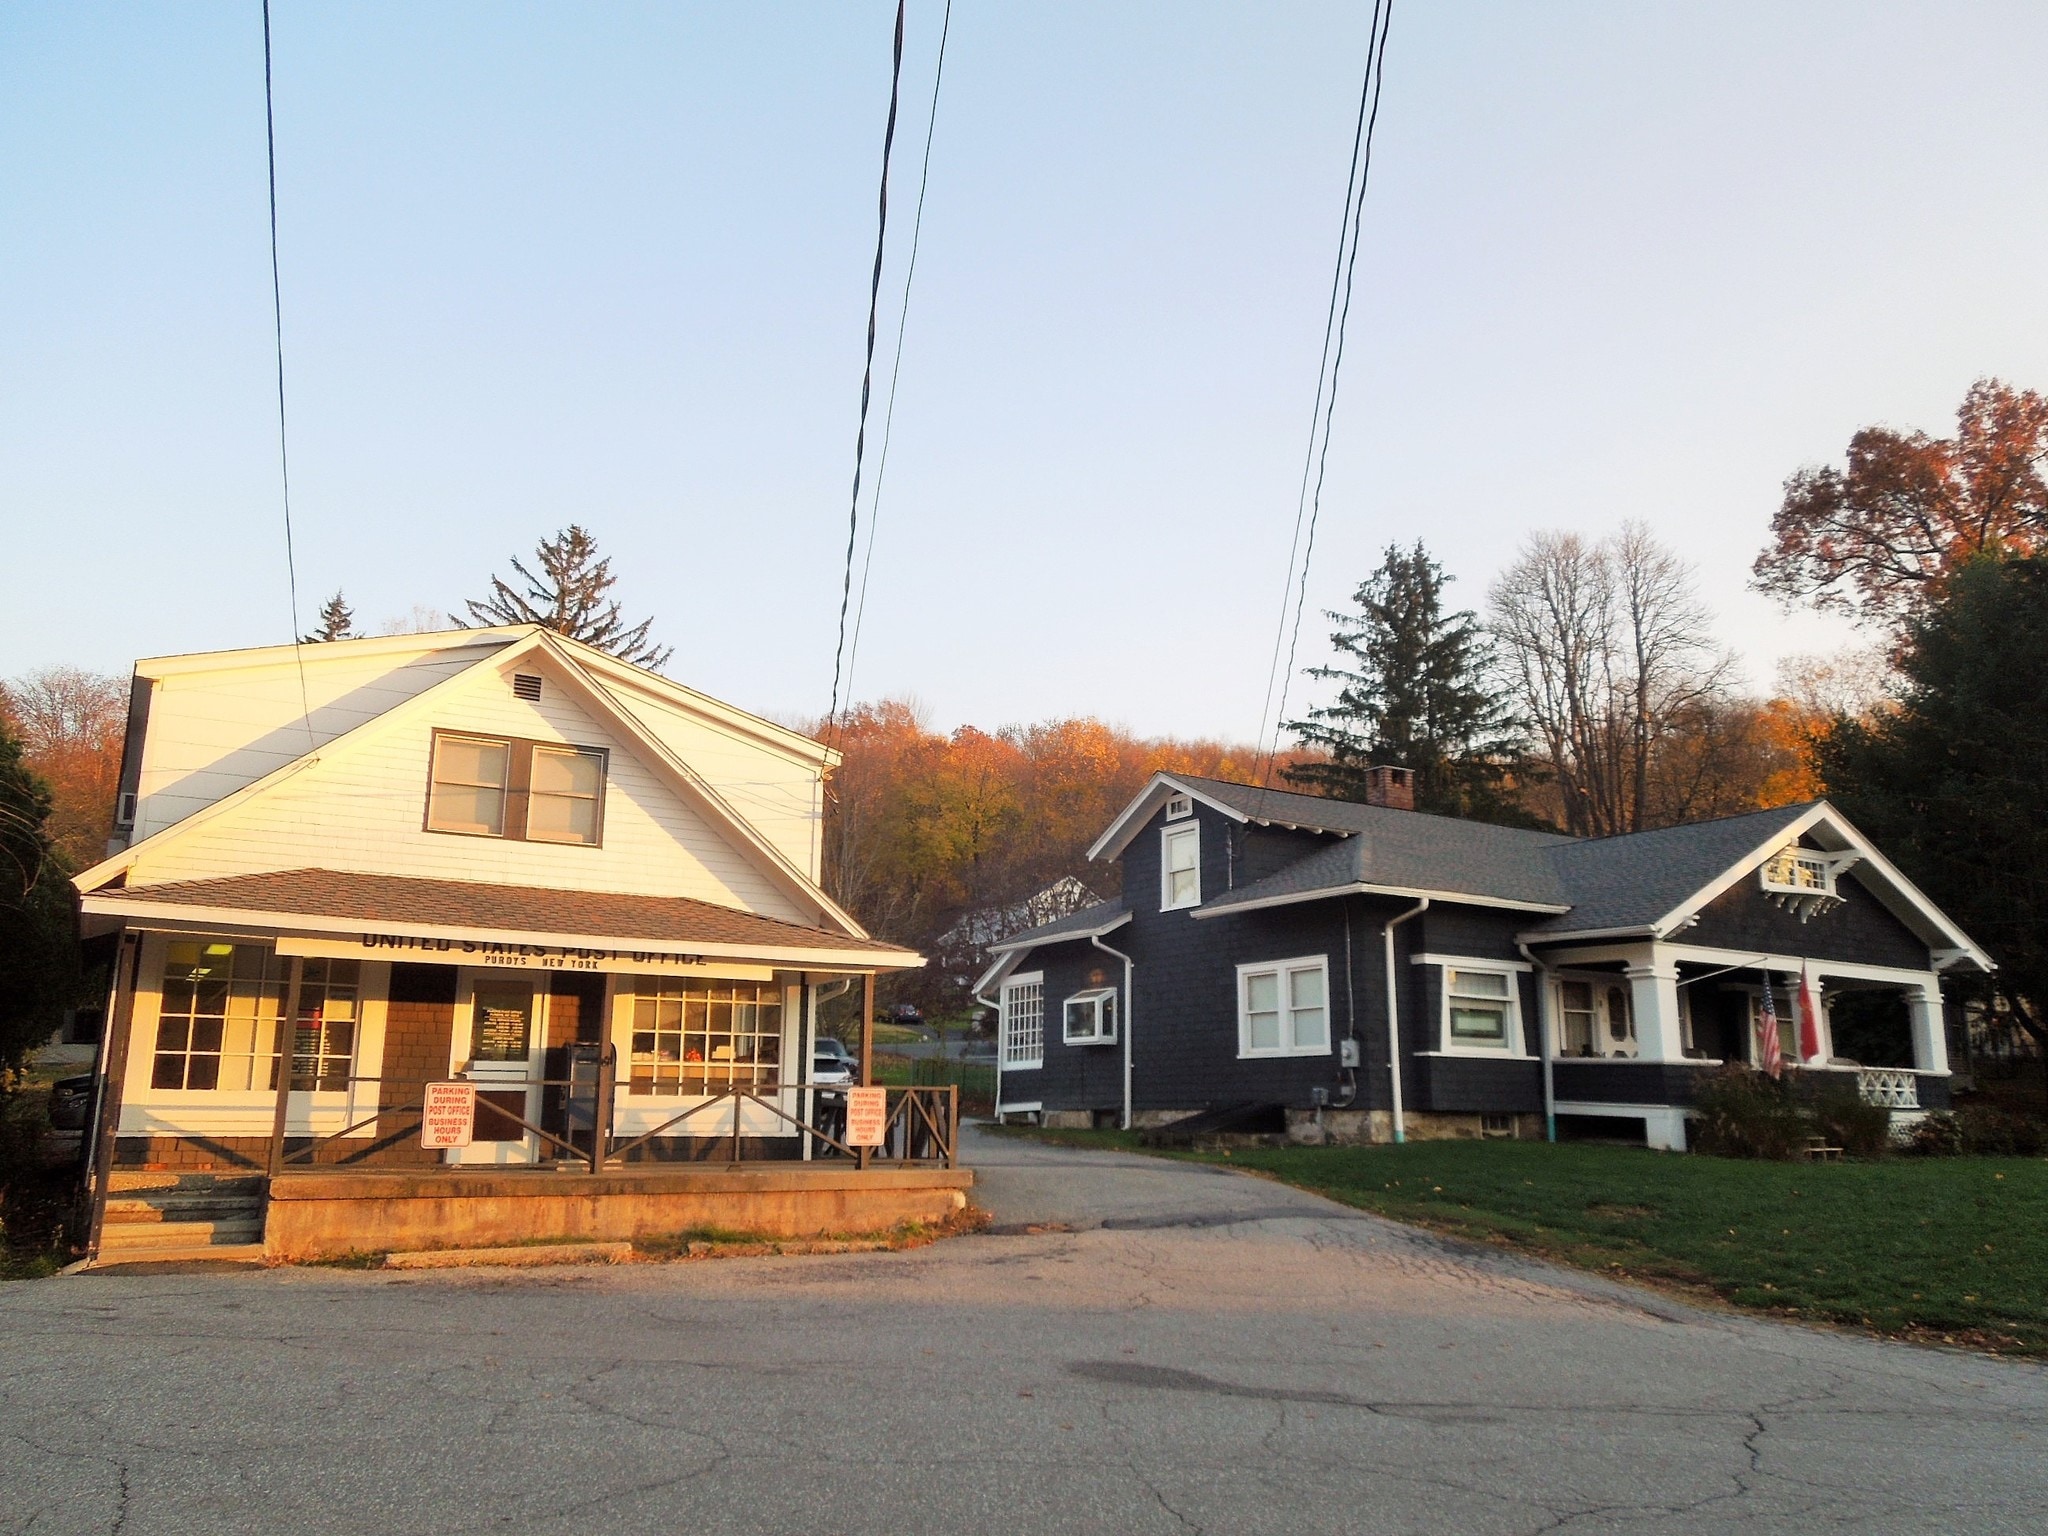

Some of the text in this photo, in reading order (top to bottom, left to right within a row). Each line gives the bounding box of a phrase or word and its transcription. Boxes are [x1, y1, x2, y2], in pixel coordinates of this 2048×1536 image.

[362, 933, 450, 951] UNITED
[484, 955, 598, 970] PURDYS NEW YORK
[431, 1087, 470, 1095] PARKING
[433, 1096, 467, 1104] DURING
[428, 1105, 471, 1116] POST OFFICE
[428, 1118, 468, 1126] BUSINESS
[433, 1126, 462, 1135] HOURS
[435, 1135, 458, 1144] ONLY
